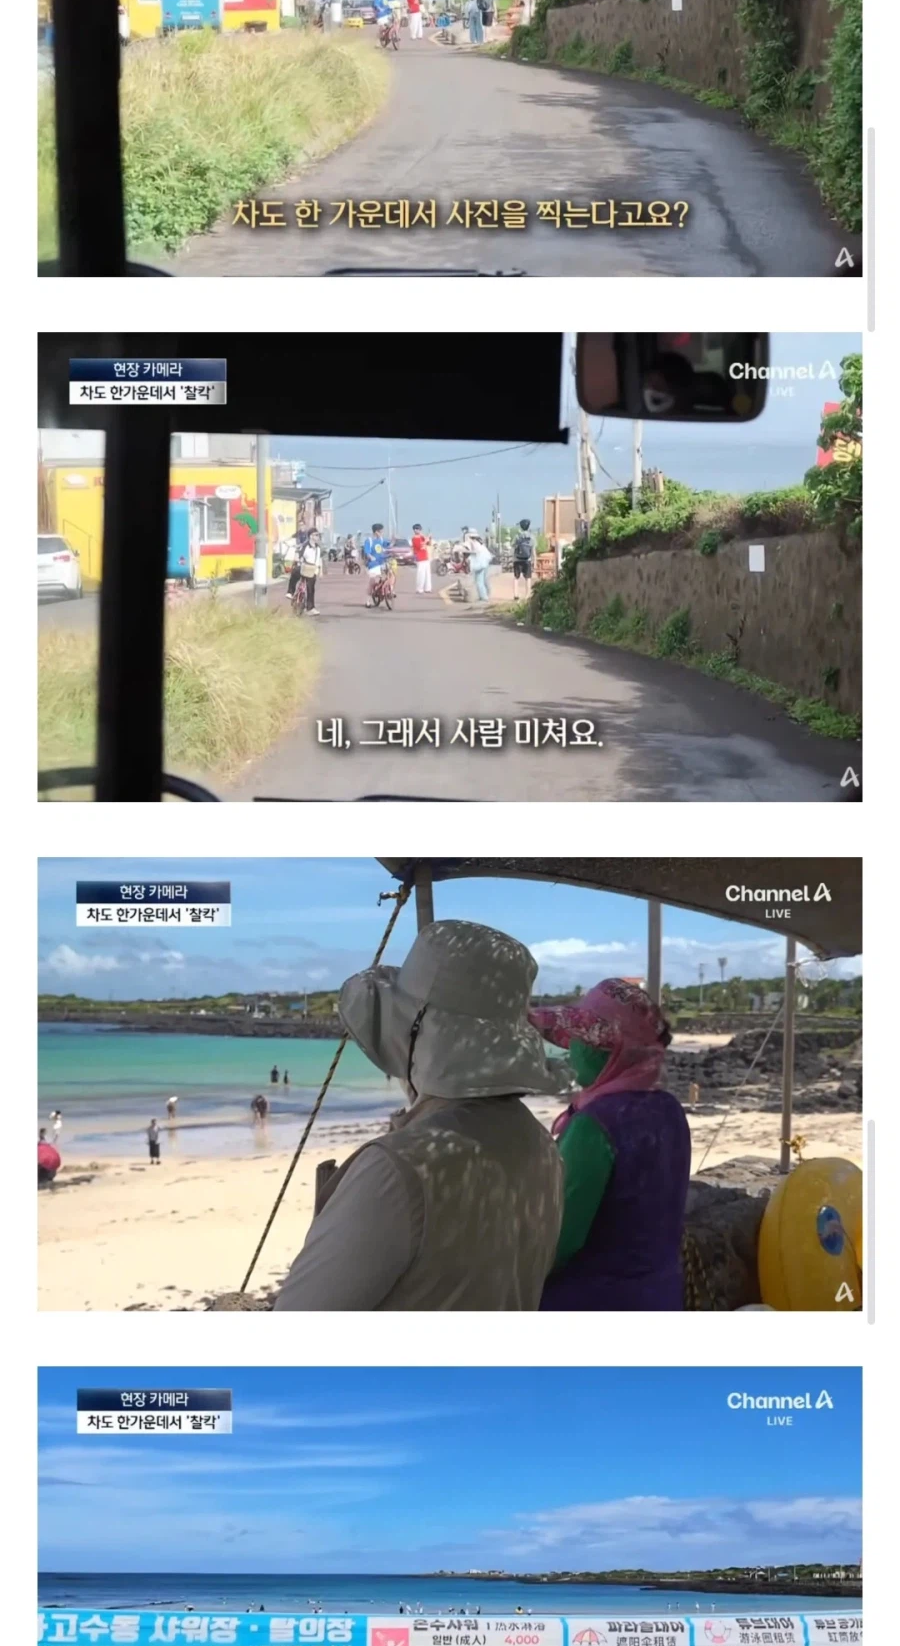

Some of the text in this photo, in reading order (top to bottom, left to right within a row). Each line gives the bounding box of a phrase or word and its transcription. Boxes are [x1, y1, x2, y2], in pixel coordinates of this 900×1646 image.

[150, 1615, 240, 1643] 샤워장
[269, 1618, 355, 1642] 탈의장
[432, 1635, 539, 1645] 일반 (成人) 4,000
